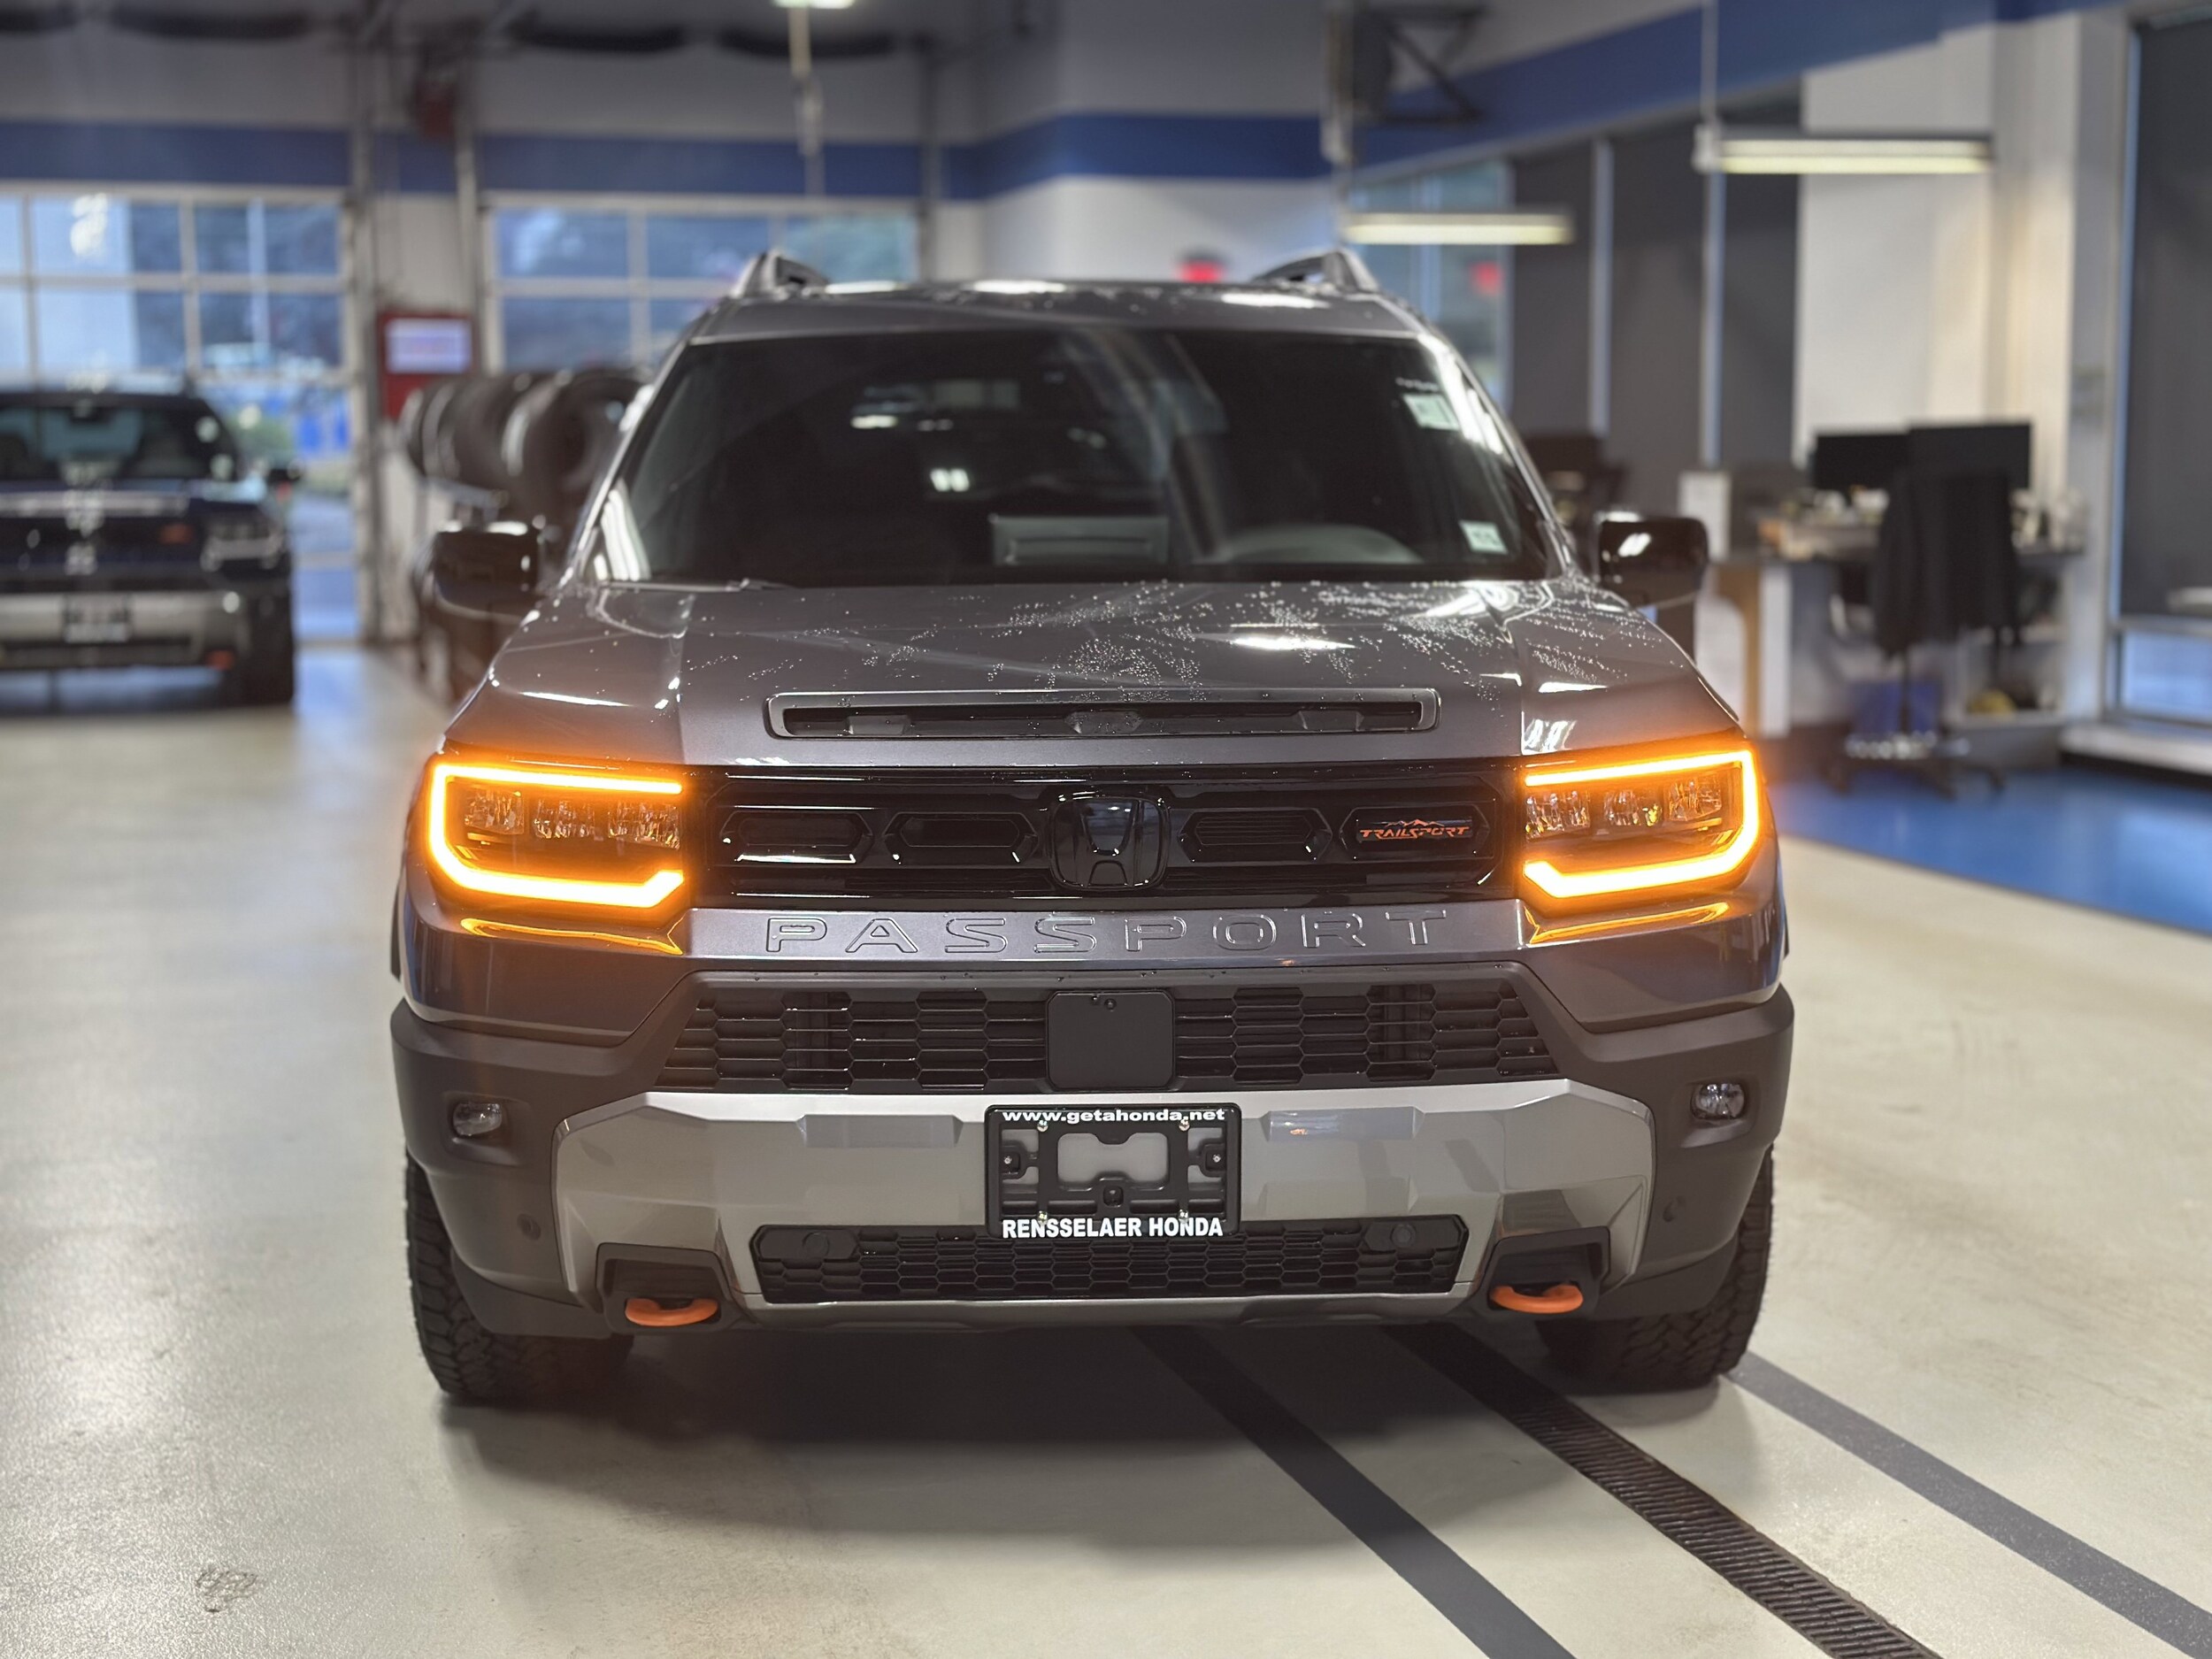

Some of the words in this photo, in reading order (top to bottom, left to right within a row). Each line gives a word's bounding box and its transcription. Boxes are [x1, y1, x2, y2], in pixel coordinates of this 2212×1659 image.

[1360, 826, 1470, 840] TRAILSPORT
[765, 909, 1447, 954] PASSPORT
[1002, 1109, 1225, 1124] www.getahonda.net
[1002, 1217, 1142, 1239] RENSSELAER
[1148, 1217, 1224, 1238] HONDA
